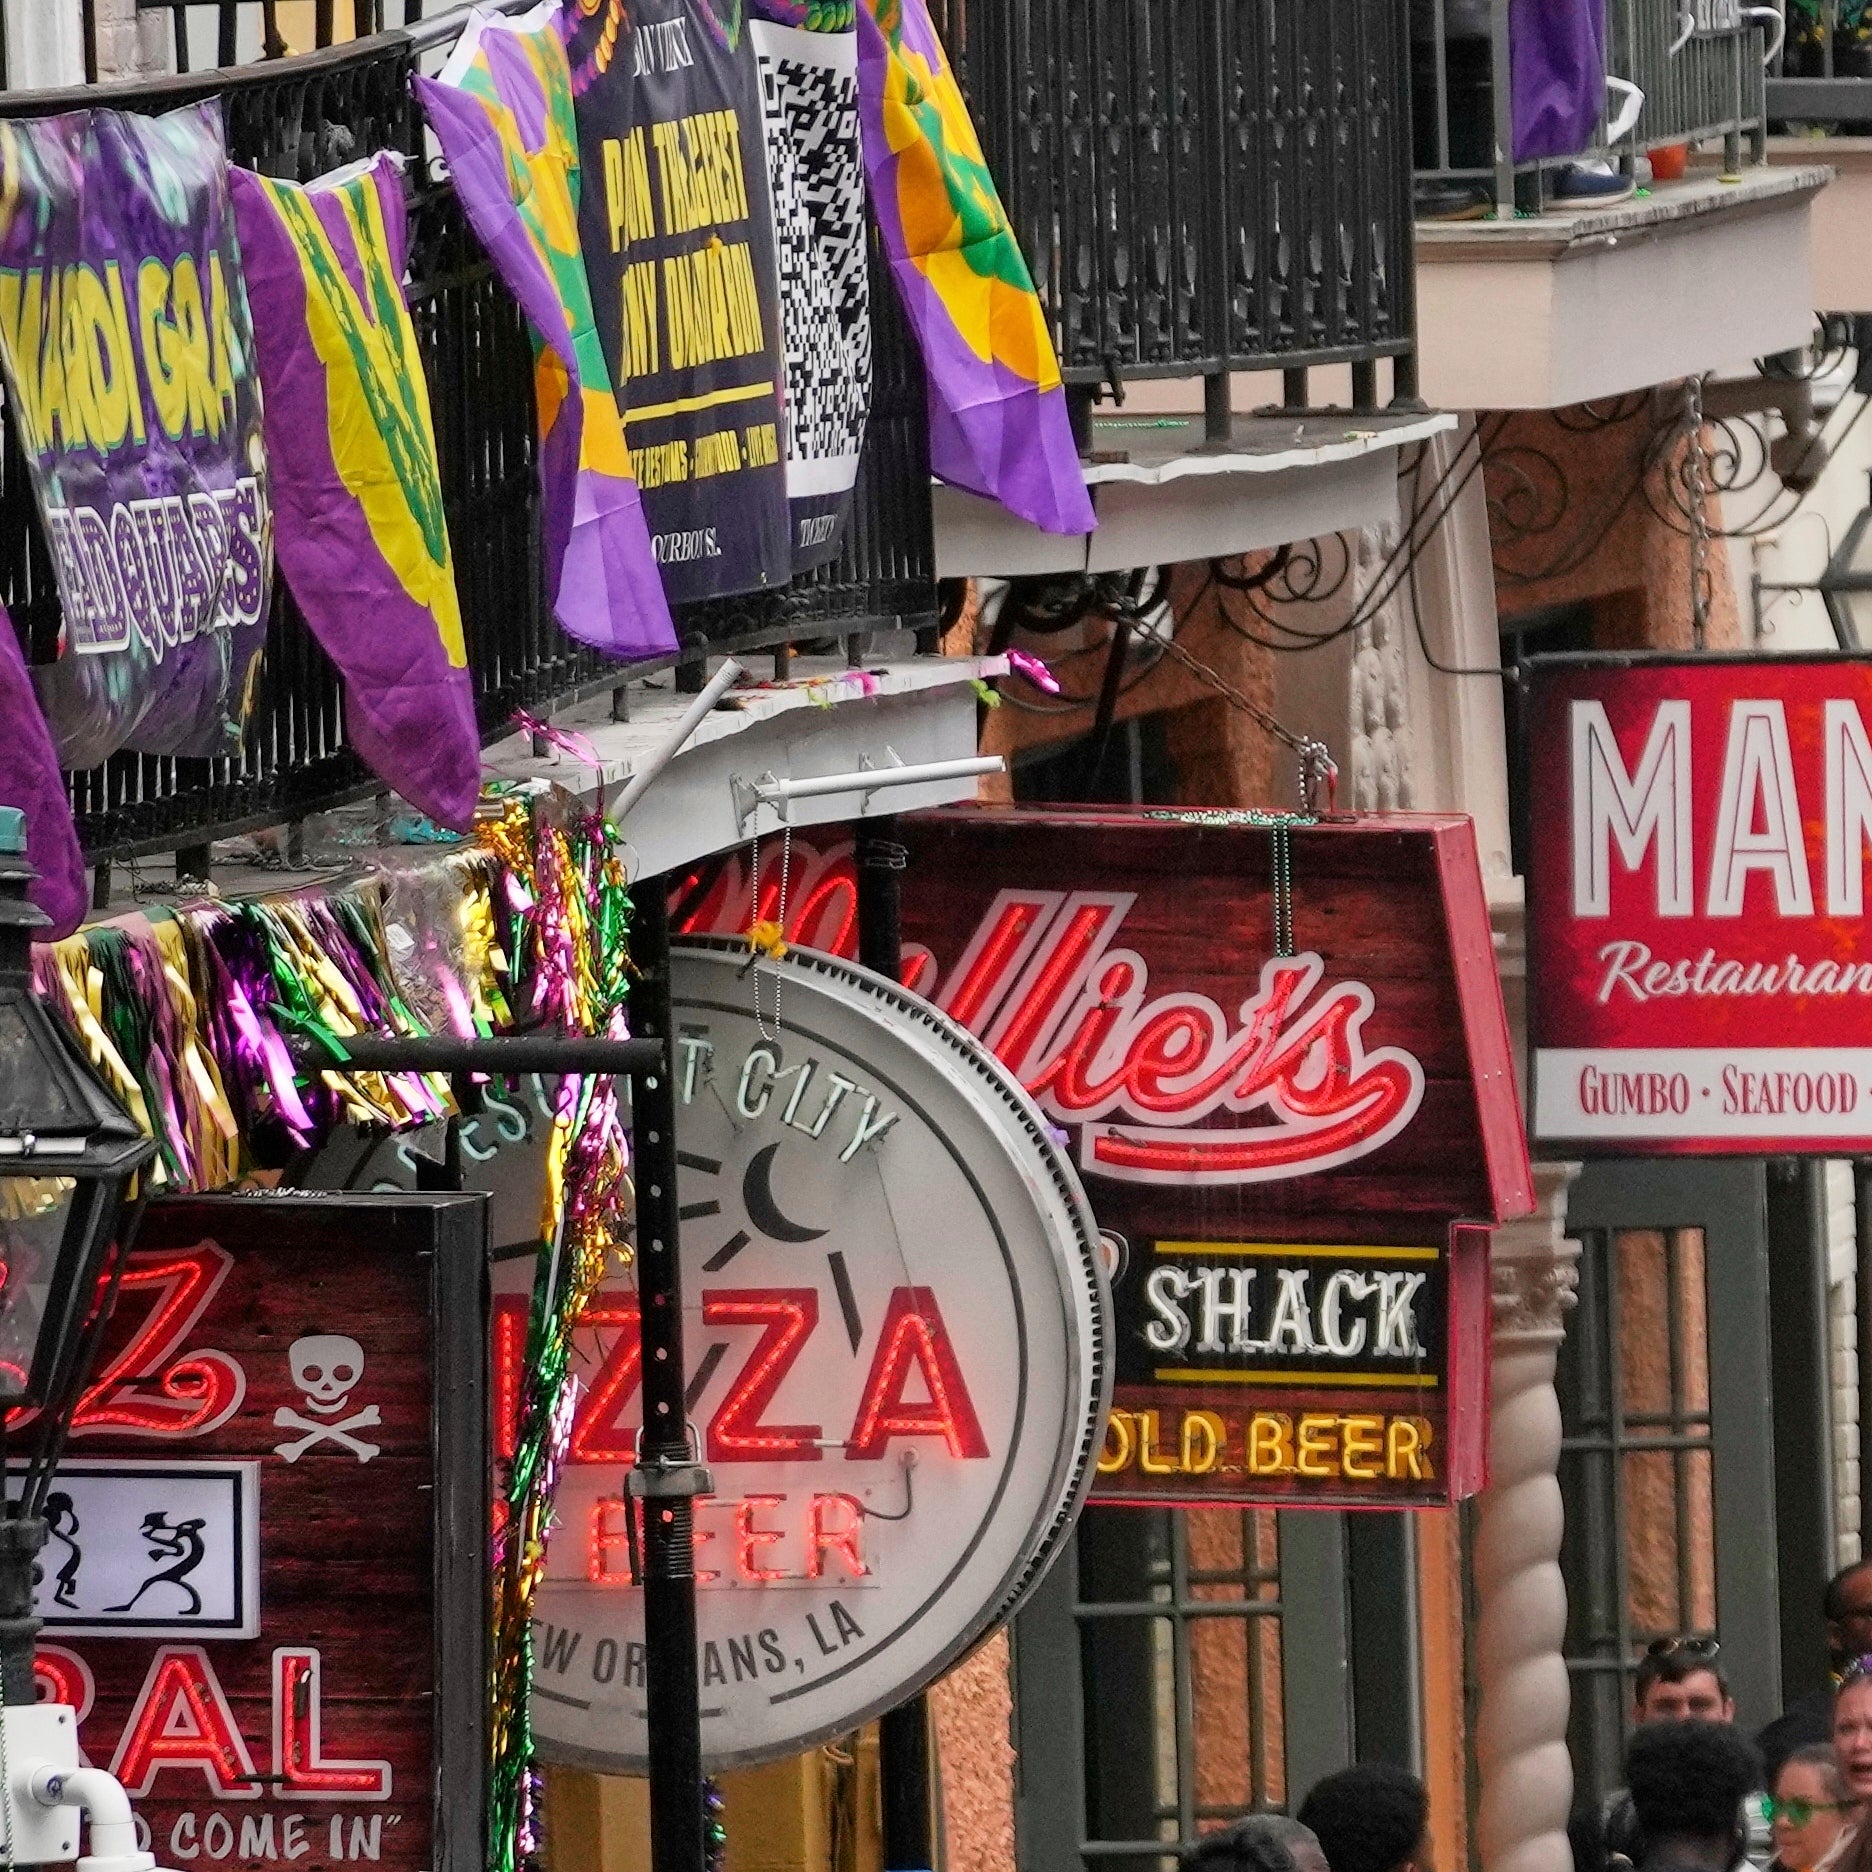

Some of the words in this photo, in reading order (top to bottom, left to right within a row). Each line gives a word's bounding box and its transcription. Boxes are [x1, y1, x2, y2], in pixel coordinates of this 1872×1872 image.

[137, 252, 238, 445] GRA
[736, 1040, 896, 1165] CITY
[1578, 1063, 1690, 1116] GUMBO
[1722, 1062, 1858, 1116] SEAFOOD
[1144, 1264, 1428, 1359] SHACK
[494, 1285, 991, 1465] IZZA
[1099, 1405, 1226, 1477] OLD
[1248, 1407, 1434, 1480] BEER
[593, 1627, 805, 1687] ORANS,
[806, 1600, 866, 1657] LA
[170, 1814, 310, 1861] COME
